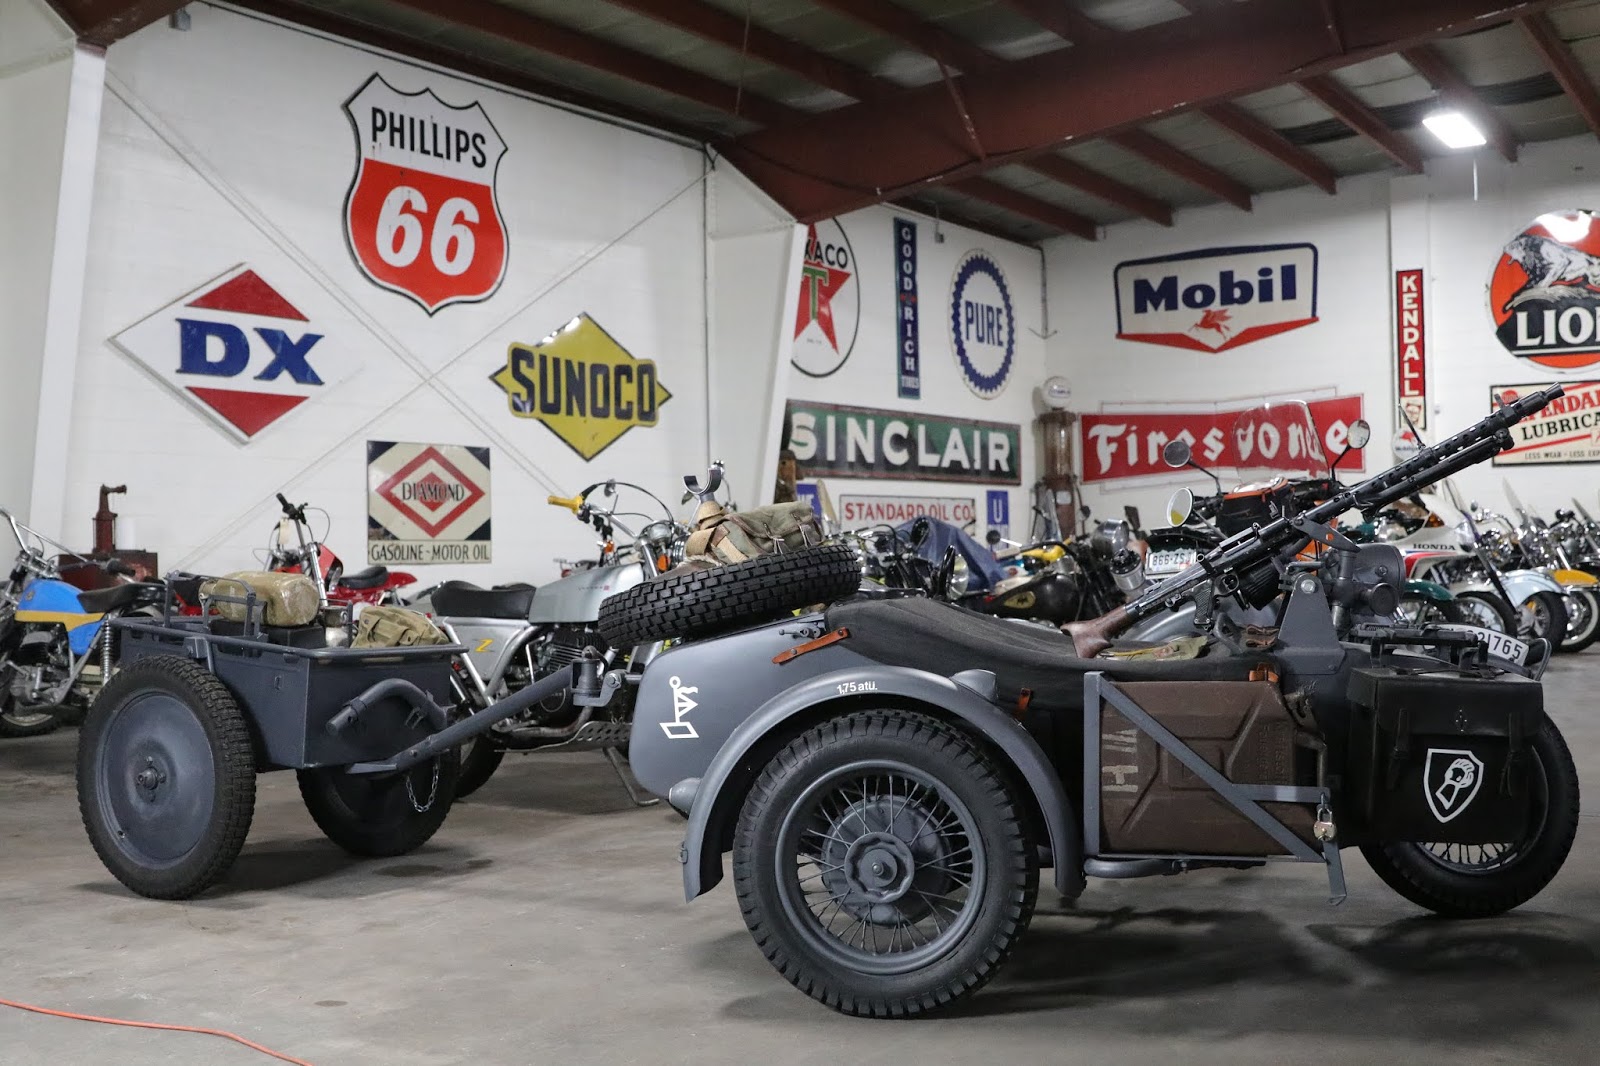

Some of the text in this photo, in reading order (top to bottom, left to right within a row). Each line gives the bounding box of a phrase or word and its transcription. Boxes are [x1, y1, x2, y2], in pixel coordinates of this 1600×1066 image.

[371, 106, 487, 168] PHILLIPS
[375, 185, 480, 276] 66
[1133, 264, 1297, 314] Mobil
[965, 300, 1004, 347] PURE
[1402, 274, 1420, 396] KENDALL
[1516, 306, 1600, 347] LIO
[175, 318, 325, 386] DX
[511, 347, 656, 422] SUNOCO
[789, 411, 1011, 472] SINCLAIR
[402, 482, 465, 501] DIAMOND
[845, 503, 925, 520] STANDARD
[929, 504, 949, 520] OIL
[371, 544, 424, 561] GASOLINE
[431, 545, 469, 561] MOTOR
[473, 545, 490, 560] OIL
[1412, 543, 1456, 551] HONDA
[837, 681, 857, 695] 1,75
